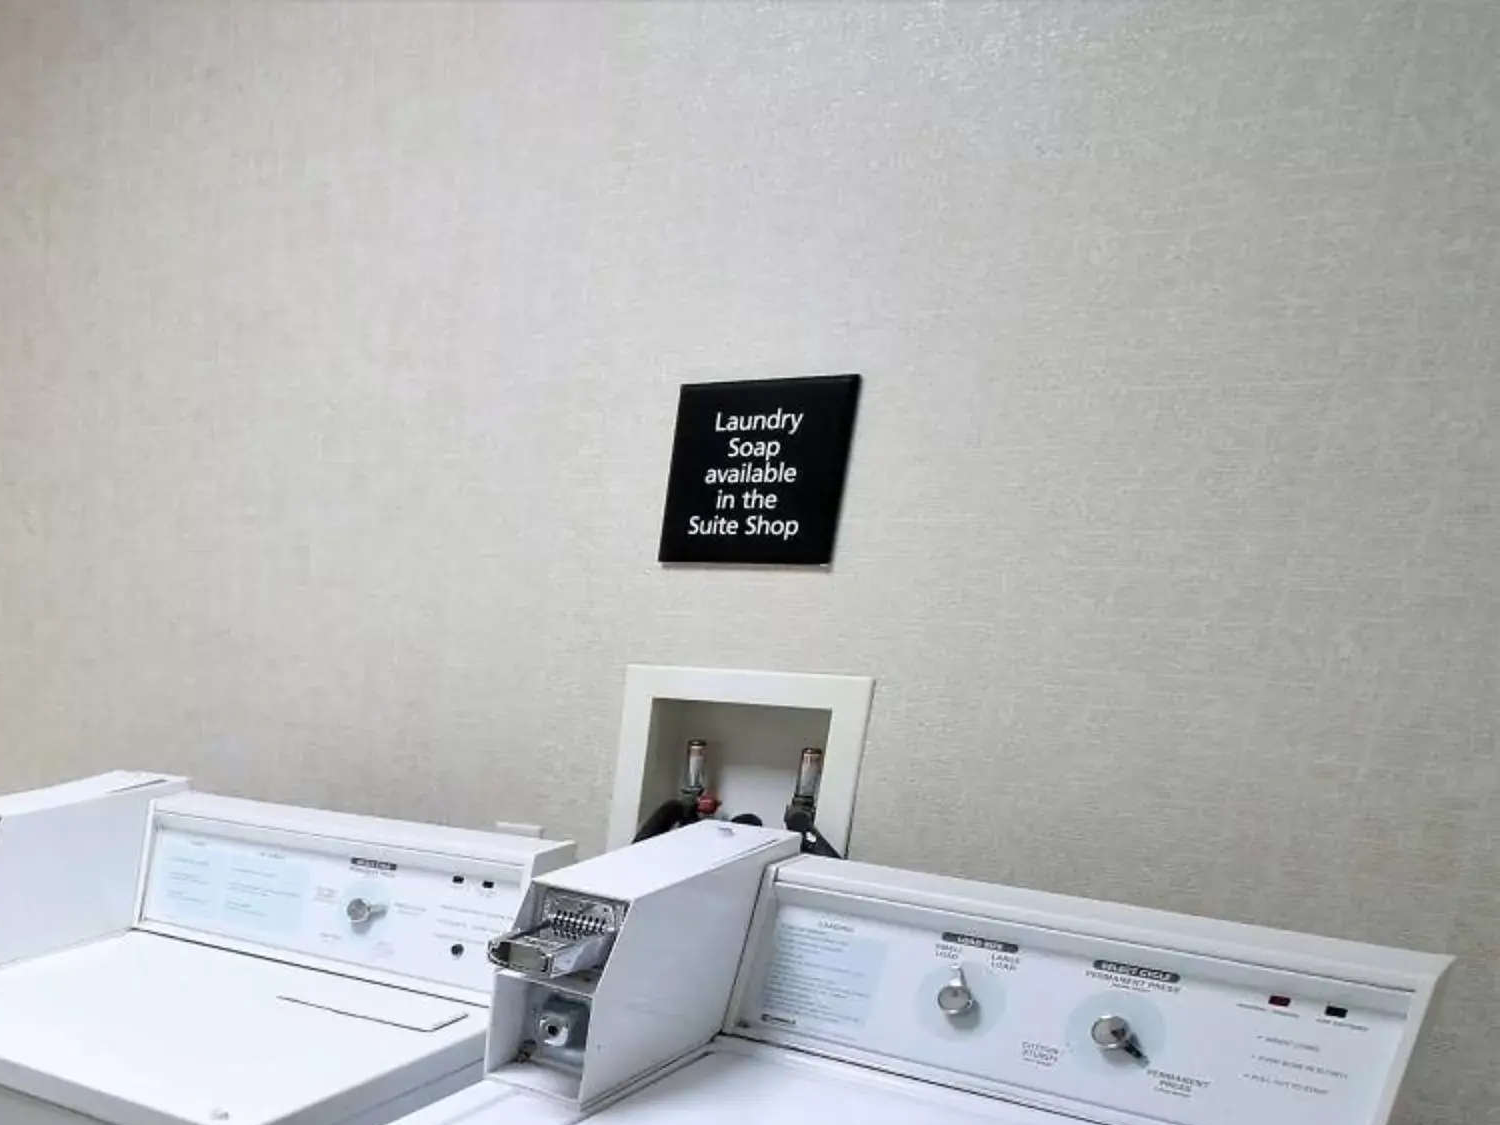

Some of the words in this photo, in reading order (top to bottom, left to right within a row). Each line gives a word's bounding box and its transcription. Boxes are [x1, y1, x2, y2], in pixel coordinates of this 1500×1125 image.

[714, 408, 804, 435] Laundry
[727, 437, 781, 460] Soap
[704, 462, 797, 484] available
[715, 490, 735, 509] in
[742, 489, 777, 509] the
[687, 516, 739, 535] Suite
[745, 515, 799, 540] Shop
